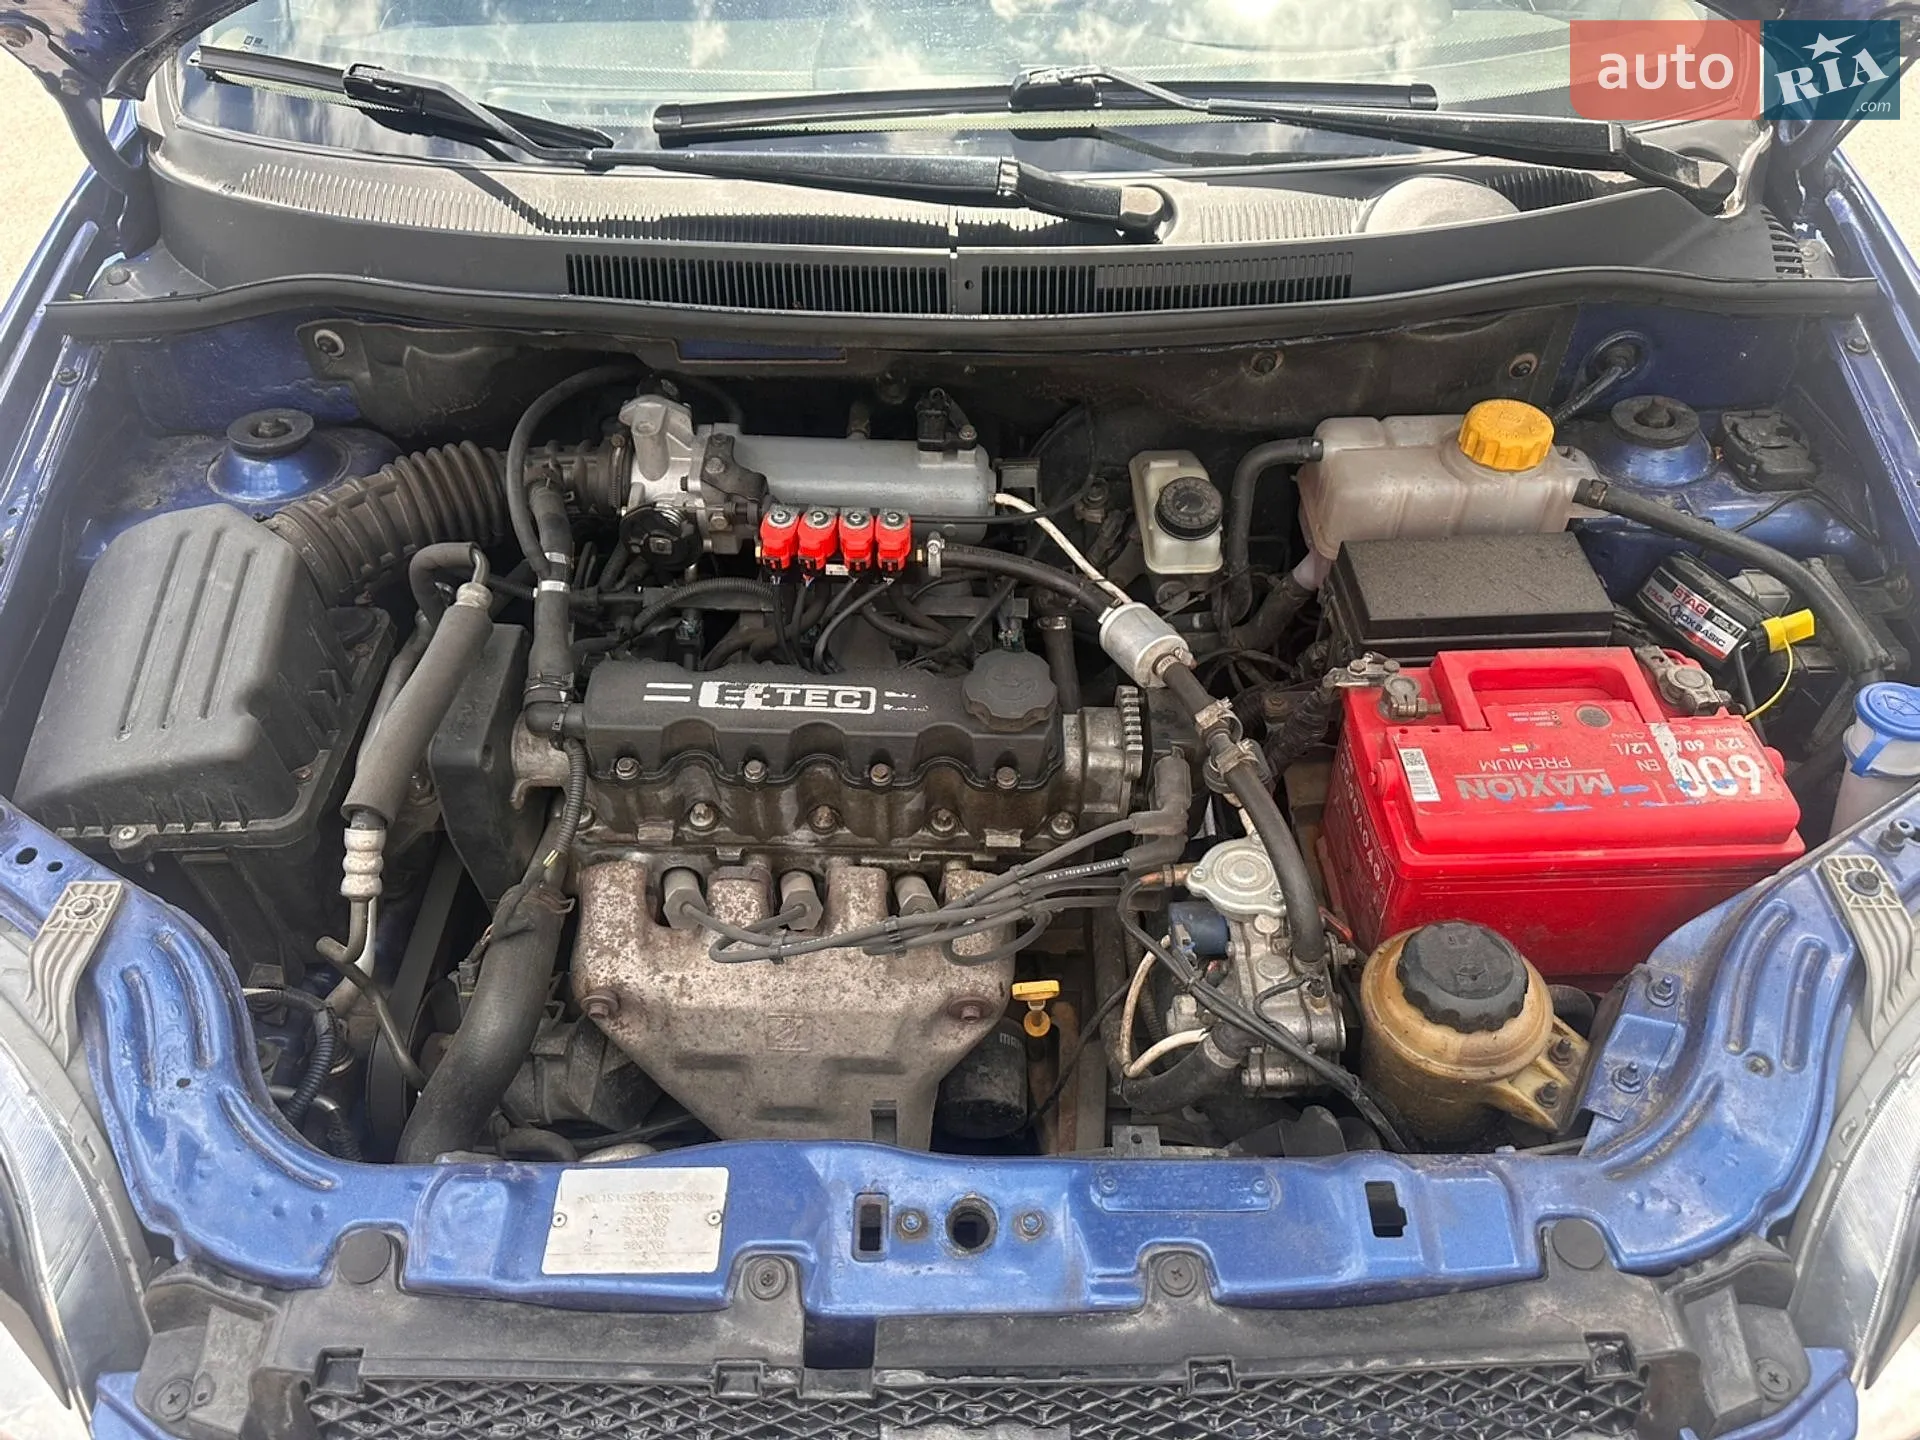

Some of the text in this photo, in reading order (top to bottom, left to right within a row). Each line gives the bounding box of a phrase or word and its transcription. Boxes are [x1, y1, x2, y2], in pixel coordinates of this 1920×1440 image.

[1672, 586, 1708, 616] STAG
[1694, 624, 1726, 647] BASIC
[1478, 755, 1572, 772] PREMIUM
[1639, 759, 1661, 772] EN
[1677, 753, 1760, 798] 600
[1454, 771, 1616, 801] MAXION
